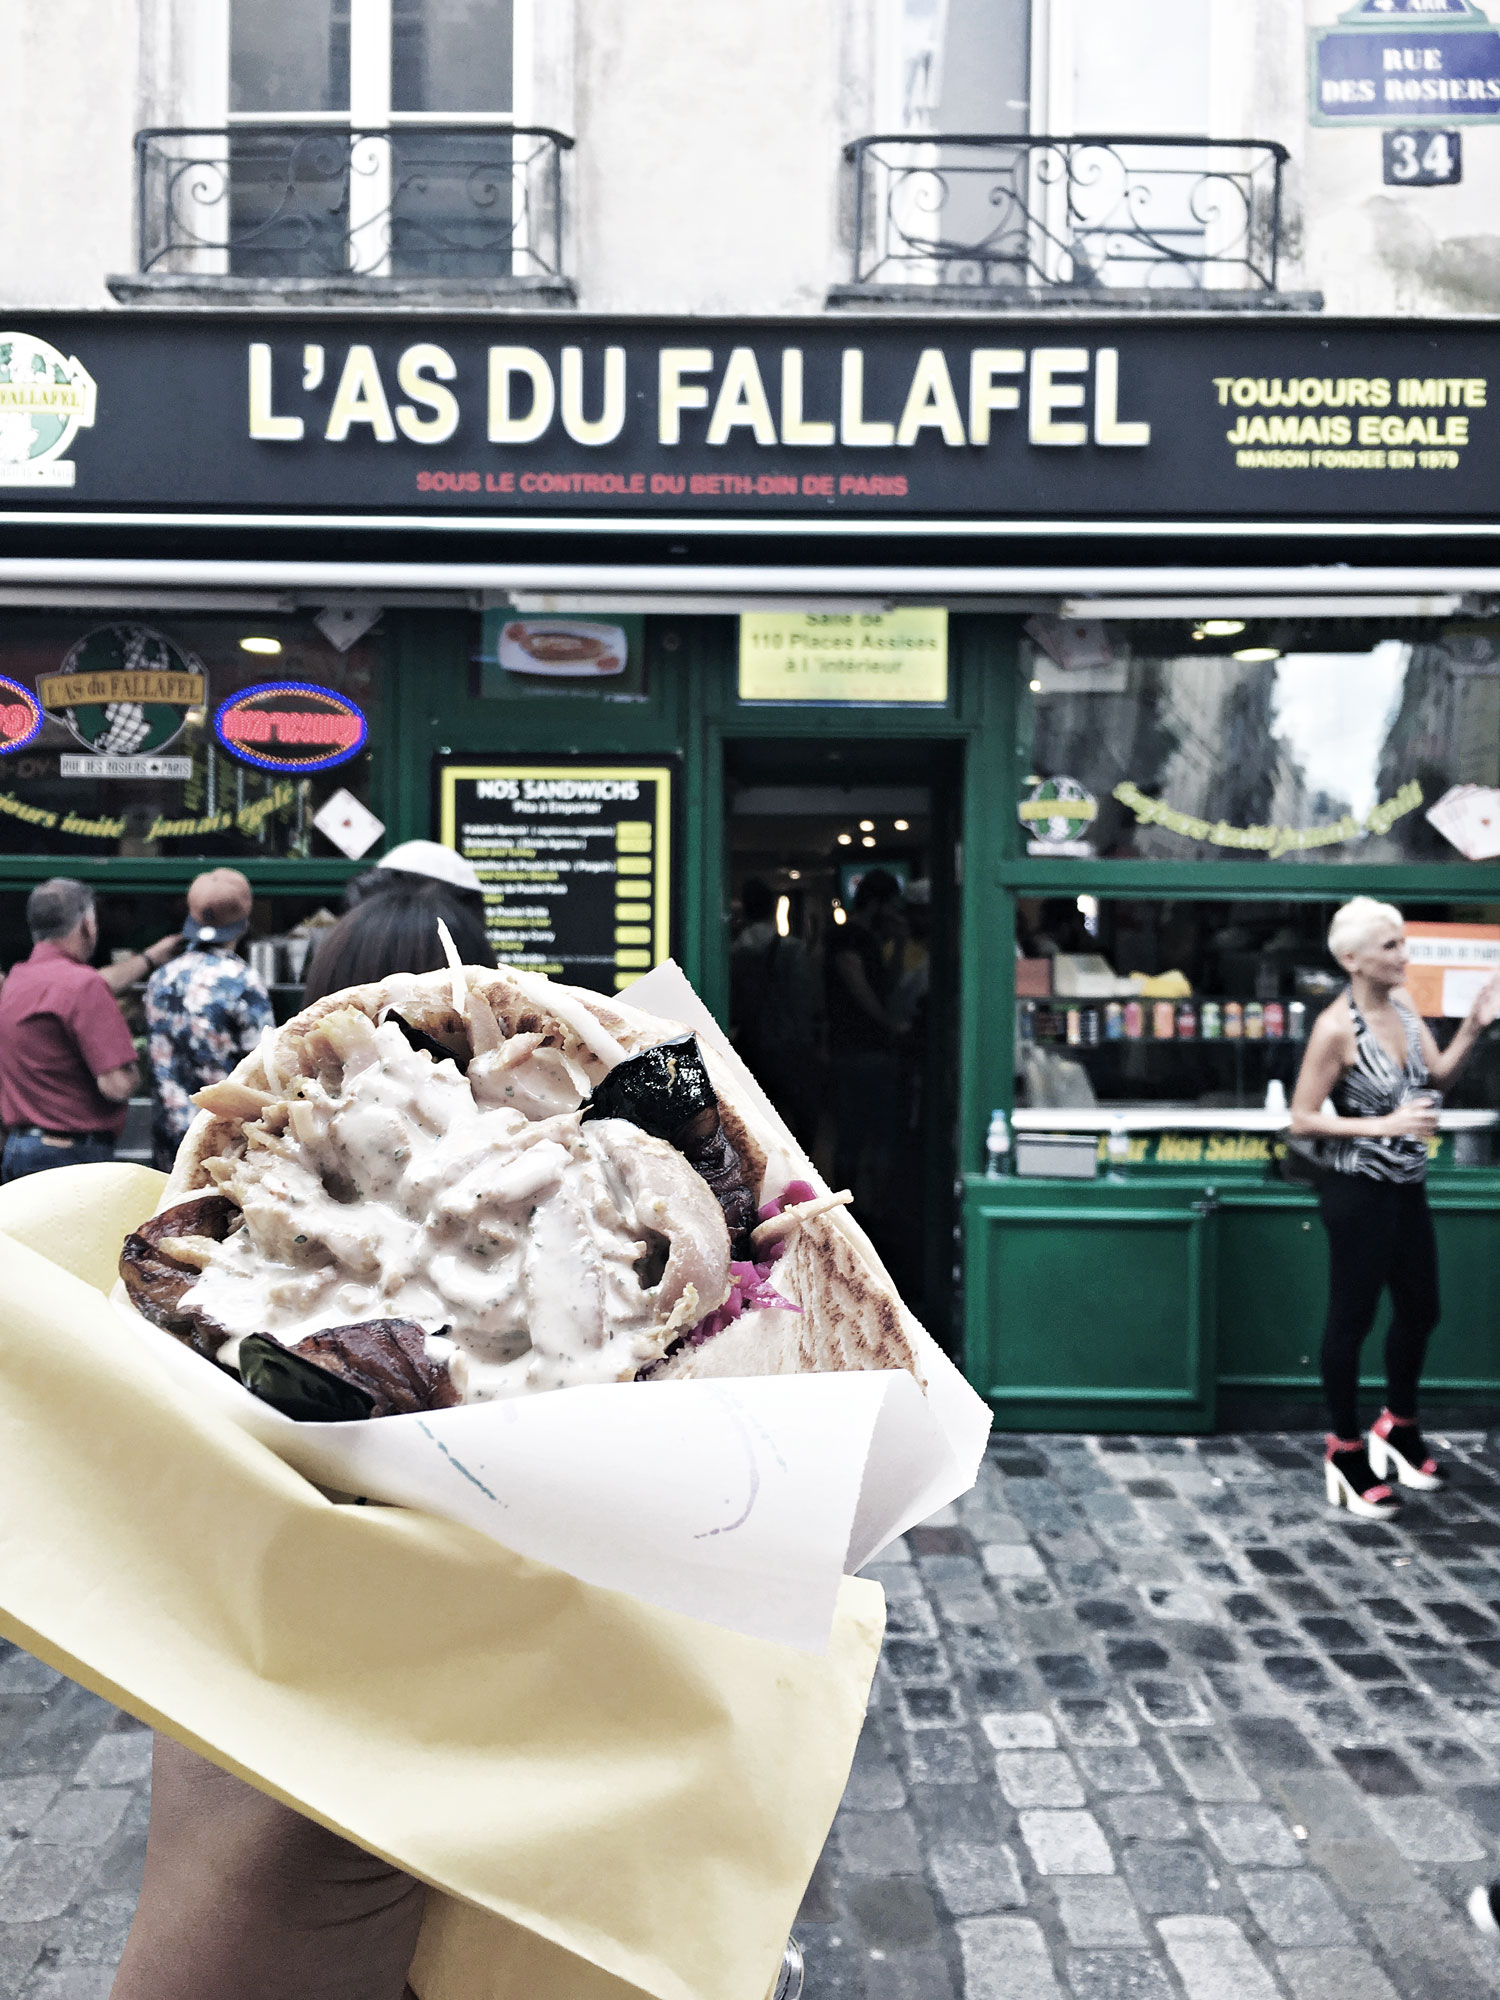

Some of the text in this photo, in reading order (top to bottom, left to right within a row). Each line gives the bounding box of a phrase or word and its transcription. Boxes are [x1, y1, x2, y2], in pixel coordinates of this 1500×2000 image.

[1382, 48, 1442, 71] RUE
[1321, 78, 1500, 102] DES ROSIERS
[1391, 134, 1454, 180] 34
[248, 342, 1151, 447] L'AS DU FALLAFEL
[1212, 377, 1487, 407] TOUJOURS IMITE
[1226, 415, 1469, 446] JAMAIS EGALE
[1236, 450, 1310, 469] MAISON
[1388, 450, 1416, 469] EN
[416, 471, 909, 496] SOUS LE CONTROLE DU BETH-DIN DE PARIS
[752, 633, 938, 649] 110 Places Assises
[110, 675, 200, 699] FALLAFEL
[106, 761, 147, 774] ROSIERS
[161, 762, 190, 775] PARIS
[476, 780, 640, 800] NOS SANDWICHS
